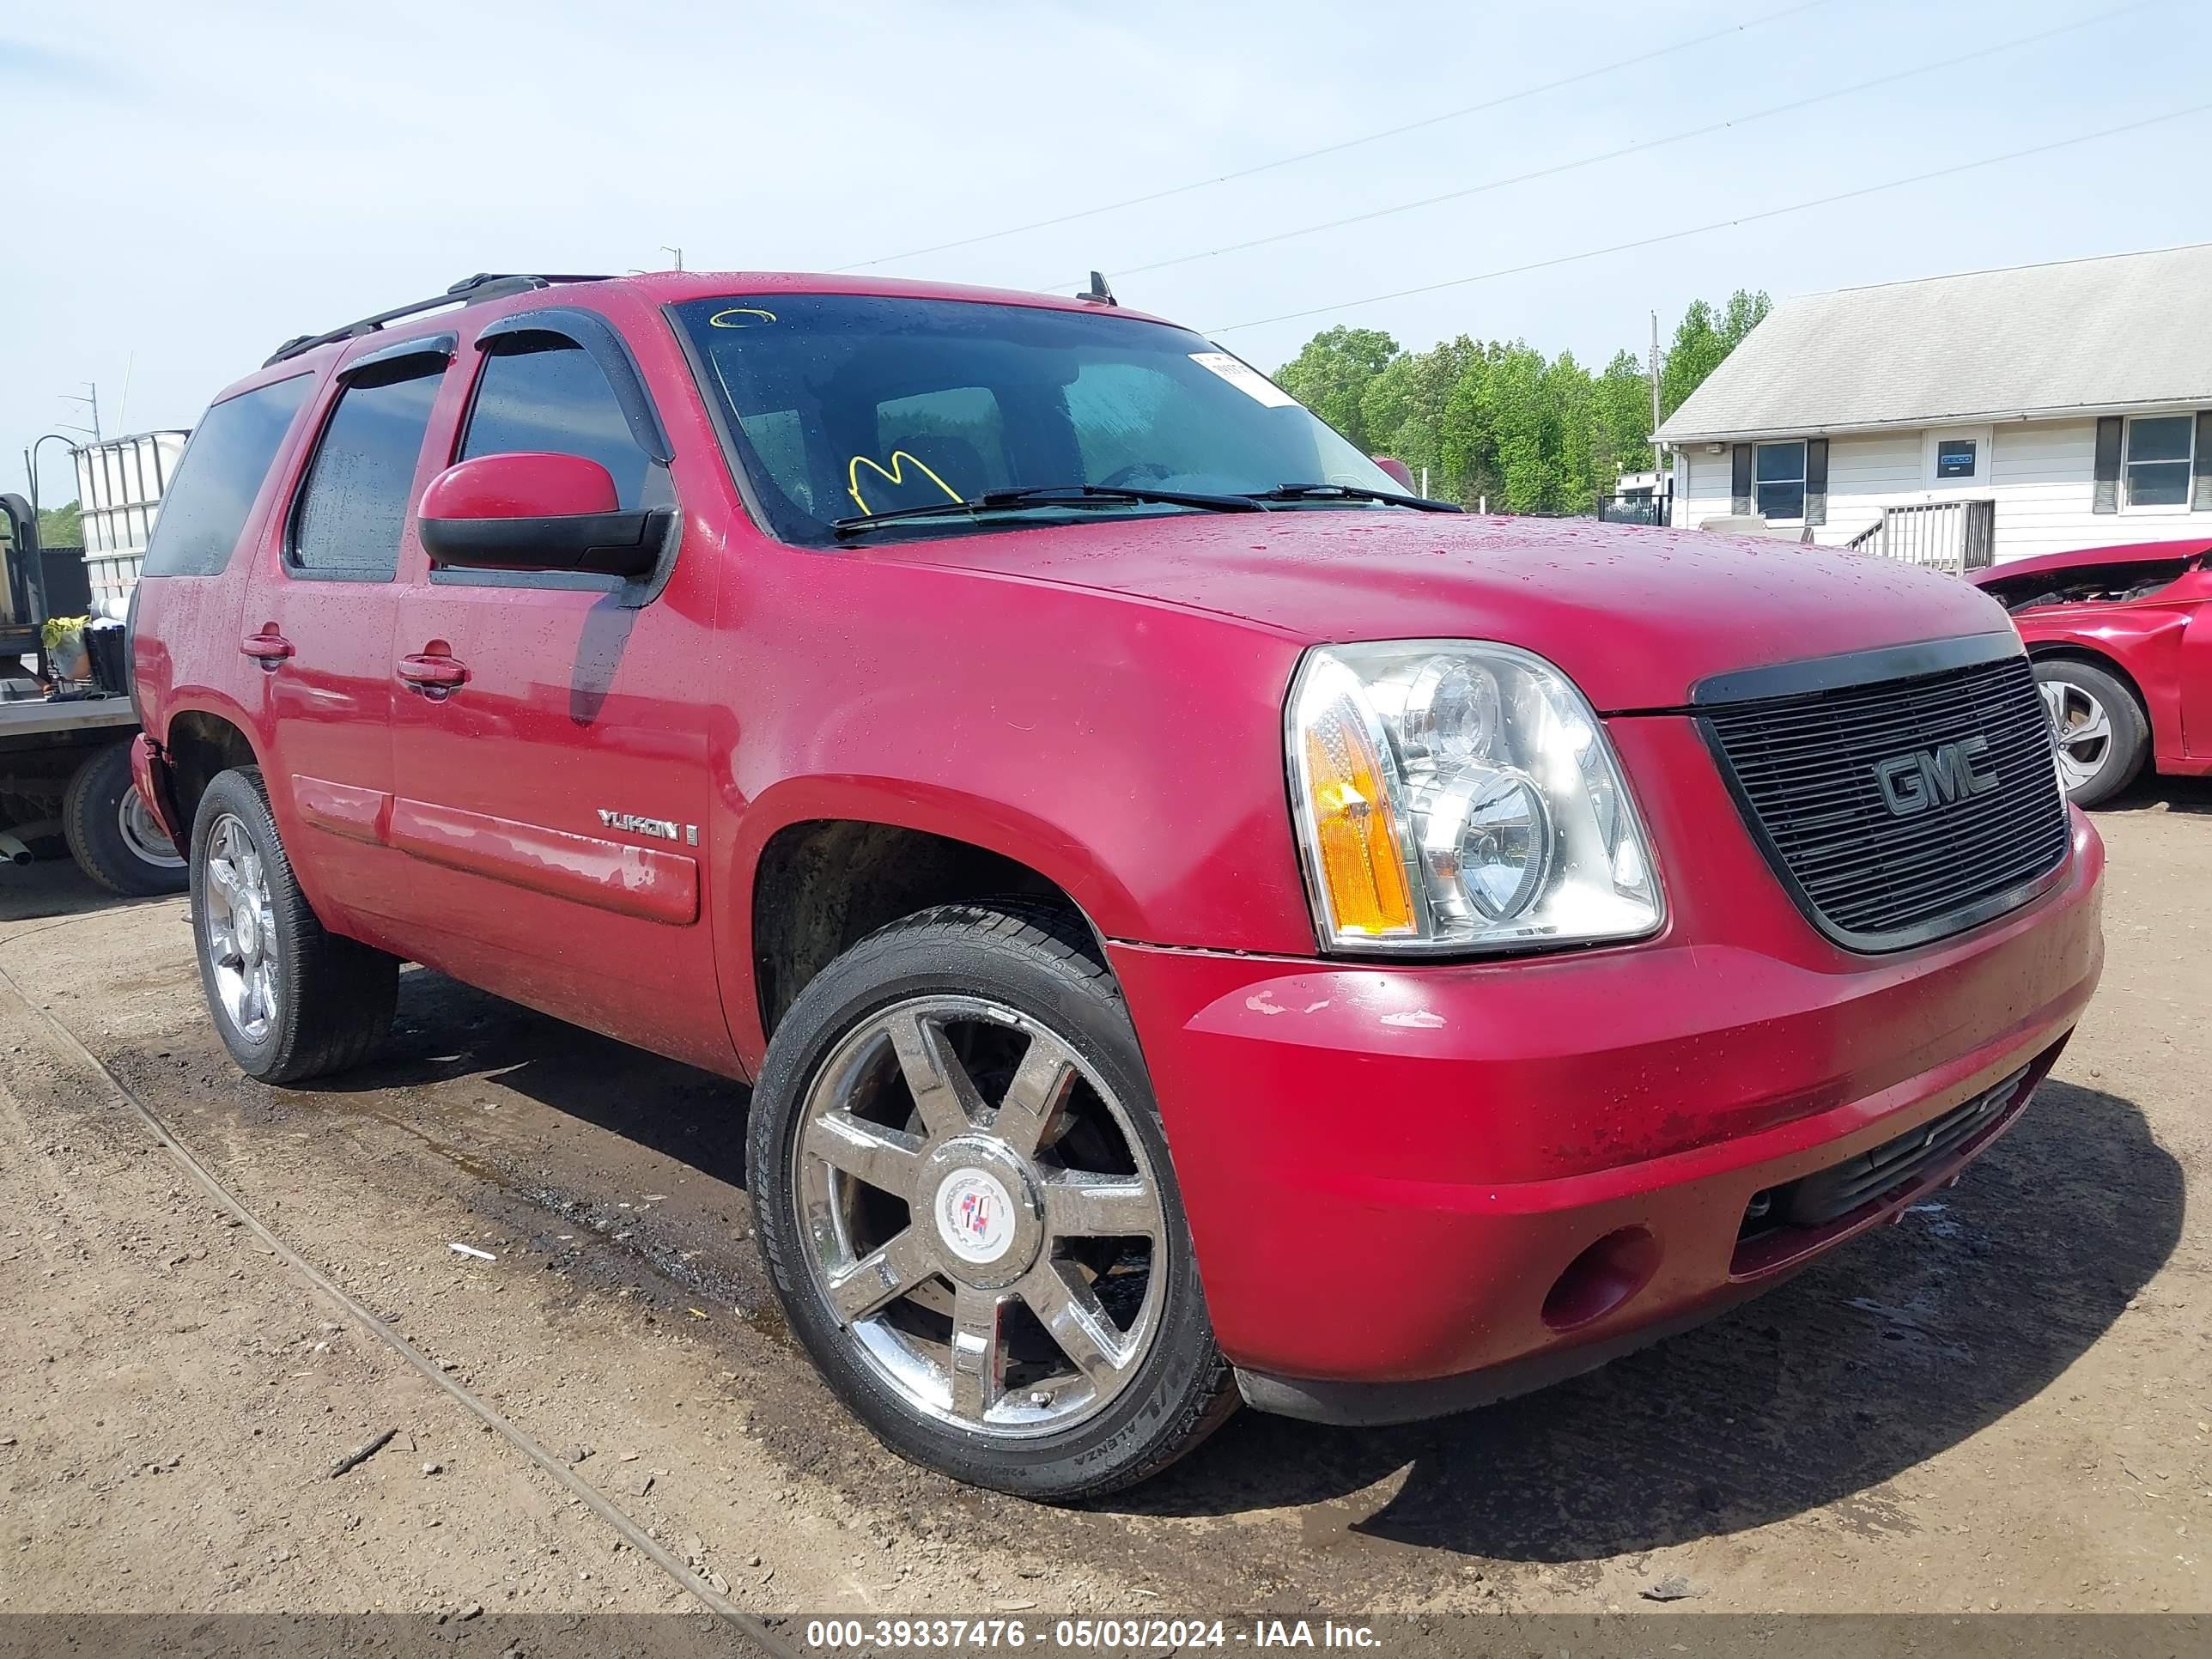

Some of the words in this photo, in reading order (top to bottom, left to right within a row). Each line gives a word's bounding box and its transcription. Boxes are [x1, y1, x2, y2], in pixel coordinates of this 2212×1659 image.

[1942, 455, 1971, 464] GEICO
[1872, 735, 2001, 817] GMC
[597, 808, 681, 842] YUKON
[1074, 1421, 1137, 1466] ALENZA
